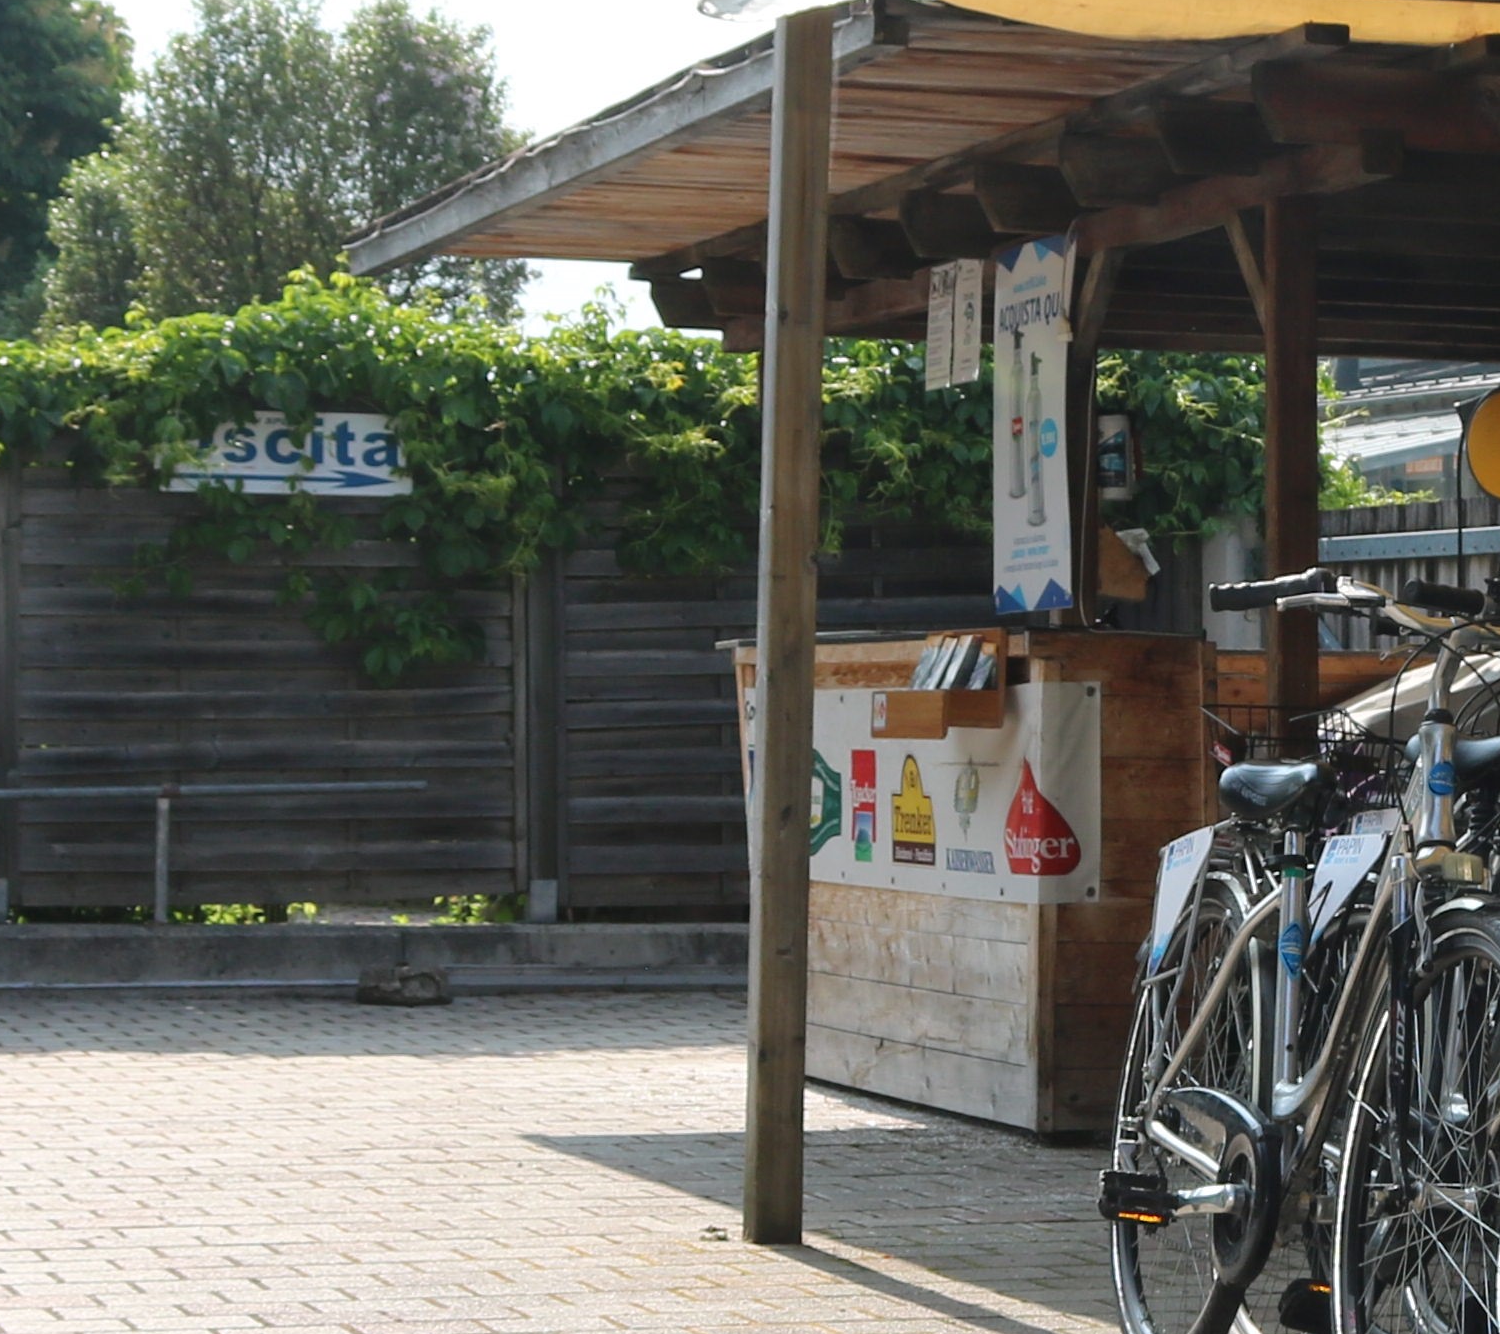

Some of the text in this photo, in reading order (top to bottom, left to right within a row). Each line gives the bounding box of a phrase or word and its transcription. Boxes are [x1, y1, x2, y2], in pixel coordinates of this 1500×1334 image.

[999, 296, 1041, 334] ACQUISTA
[198, 418, 398, 468] scita
[1338, 836, 1364, 857] PAPIN
